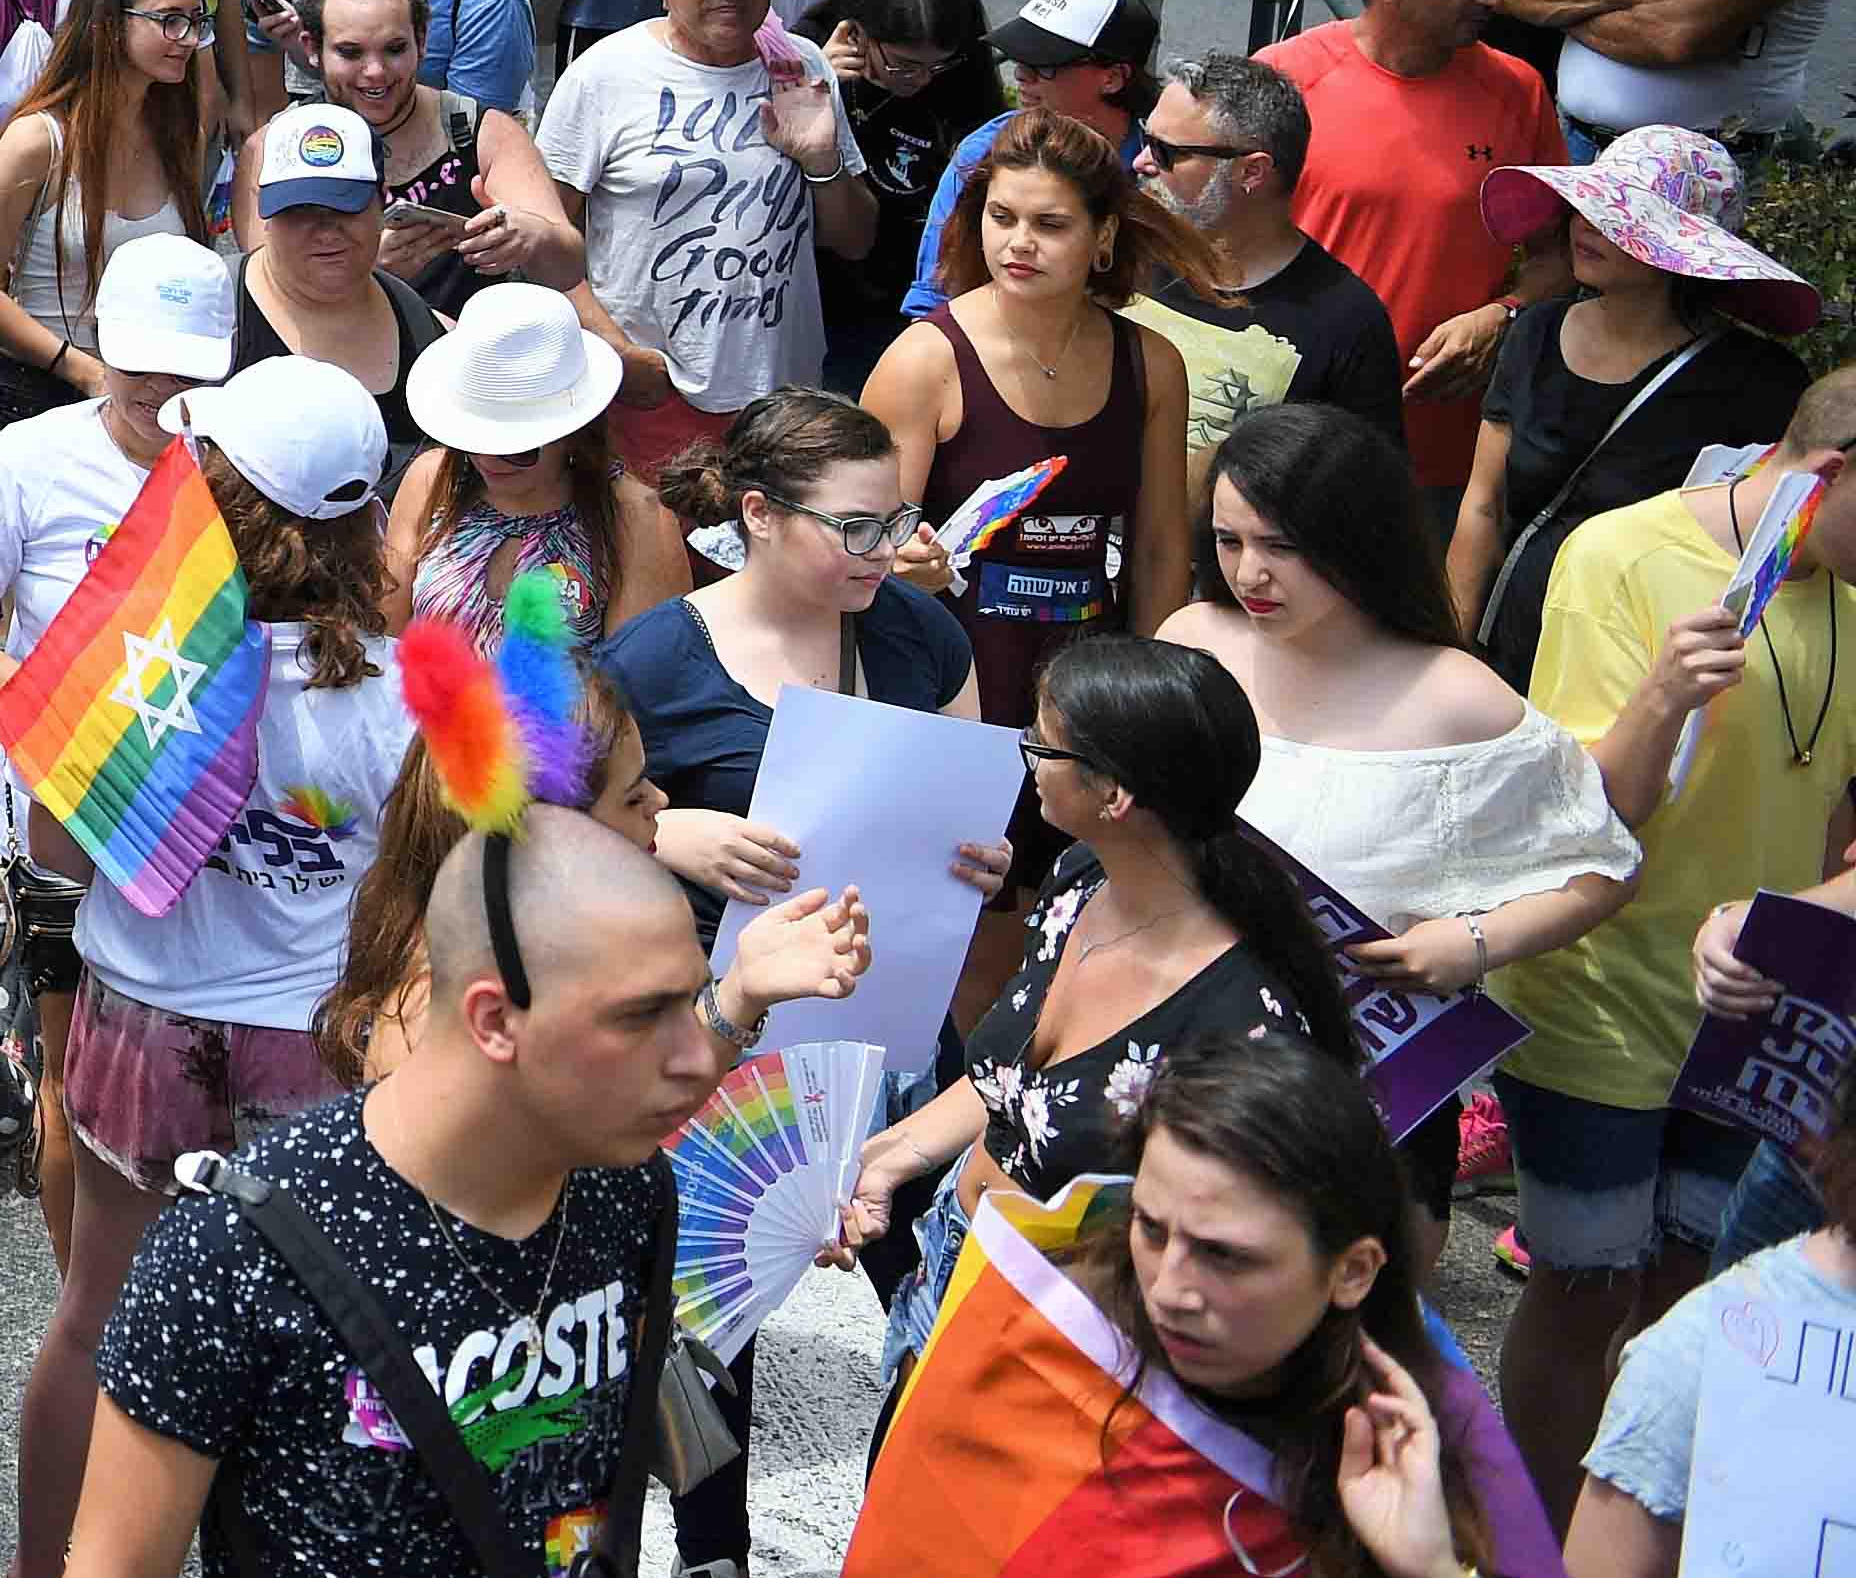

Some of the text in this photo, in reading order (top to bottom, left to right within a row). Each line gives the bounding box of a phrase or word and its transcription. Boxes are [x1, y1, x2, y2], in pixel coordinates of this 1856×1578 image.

[646, 86, 772, 157] Laz
[1009, 575, 1053, 596] שווה
[1055, 581, 1078, 594] אני
[236, 866, 345, 894] יש לך בית
[414, 1279, 627, 1421] COSTE
